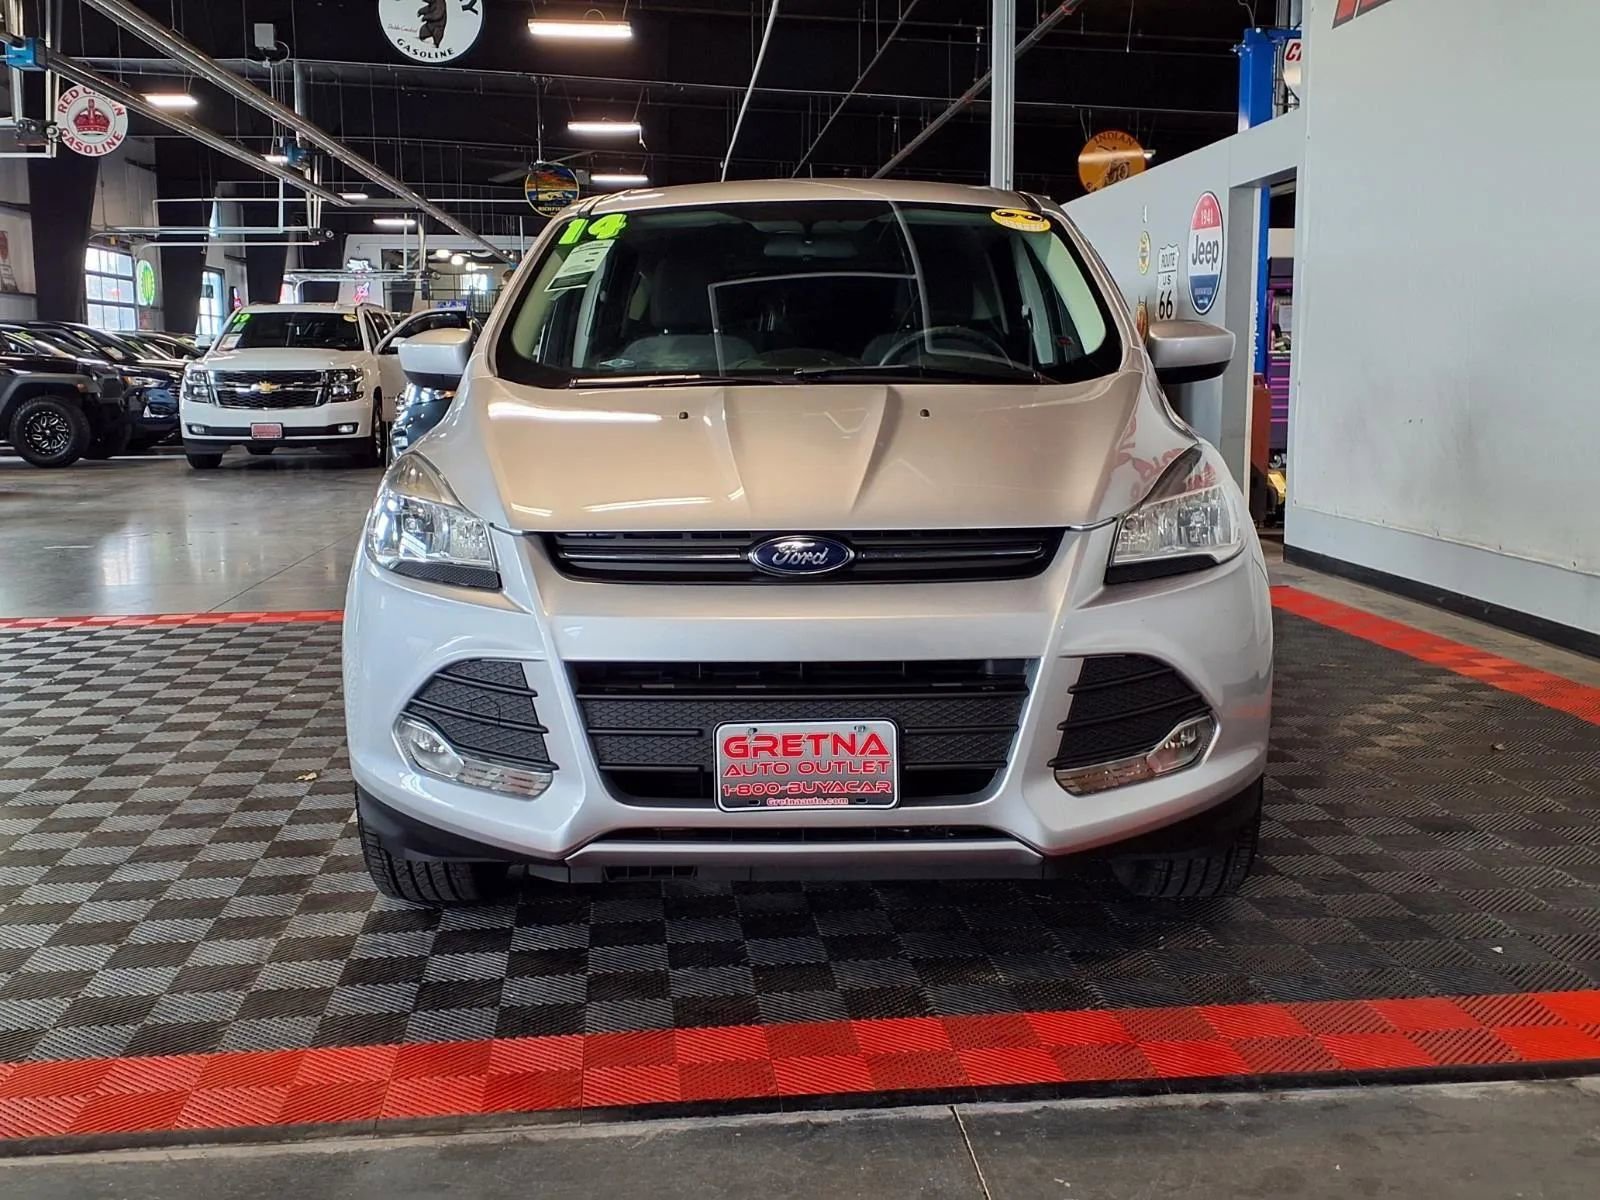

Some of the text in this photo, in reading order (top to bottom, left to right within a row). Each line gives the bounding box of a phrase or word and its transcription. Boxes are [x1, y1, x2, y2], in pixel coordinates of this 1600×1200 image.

[397, 38, 455, 59] GASOLINE
[57, 88, 80, 114] RED
[60, 127, 124, 154] GASOLINE
[1093, 131, 1135, 146] INDIAN
[558, 213, 628, 245] 14
[1161, 252, 1176, 268] ROUTE
[1192, 234, 1219, 271] Jeep
[1159, 290, 1174, 319] 66
[771, 541, 829, 565] Ford
[722, 732, 890, 760] GRETNA
[722, 760, 892, 778] AUTO OUTLET
[722, 780, 893, 797] 1-800-BUYACAR
